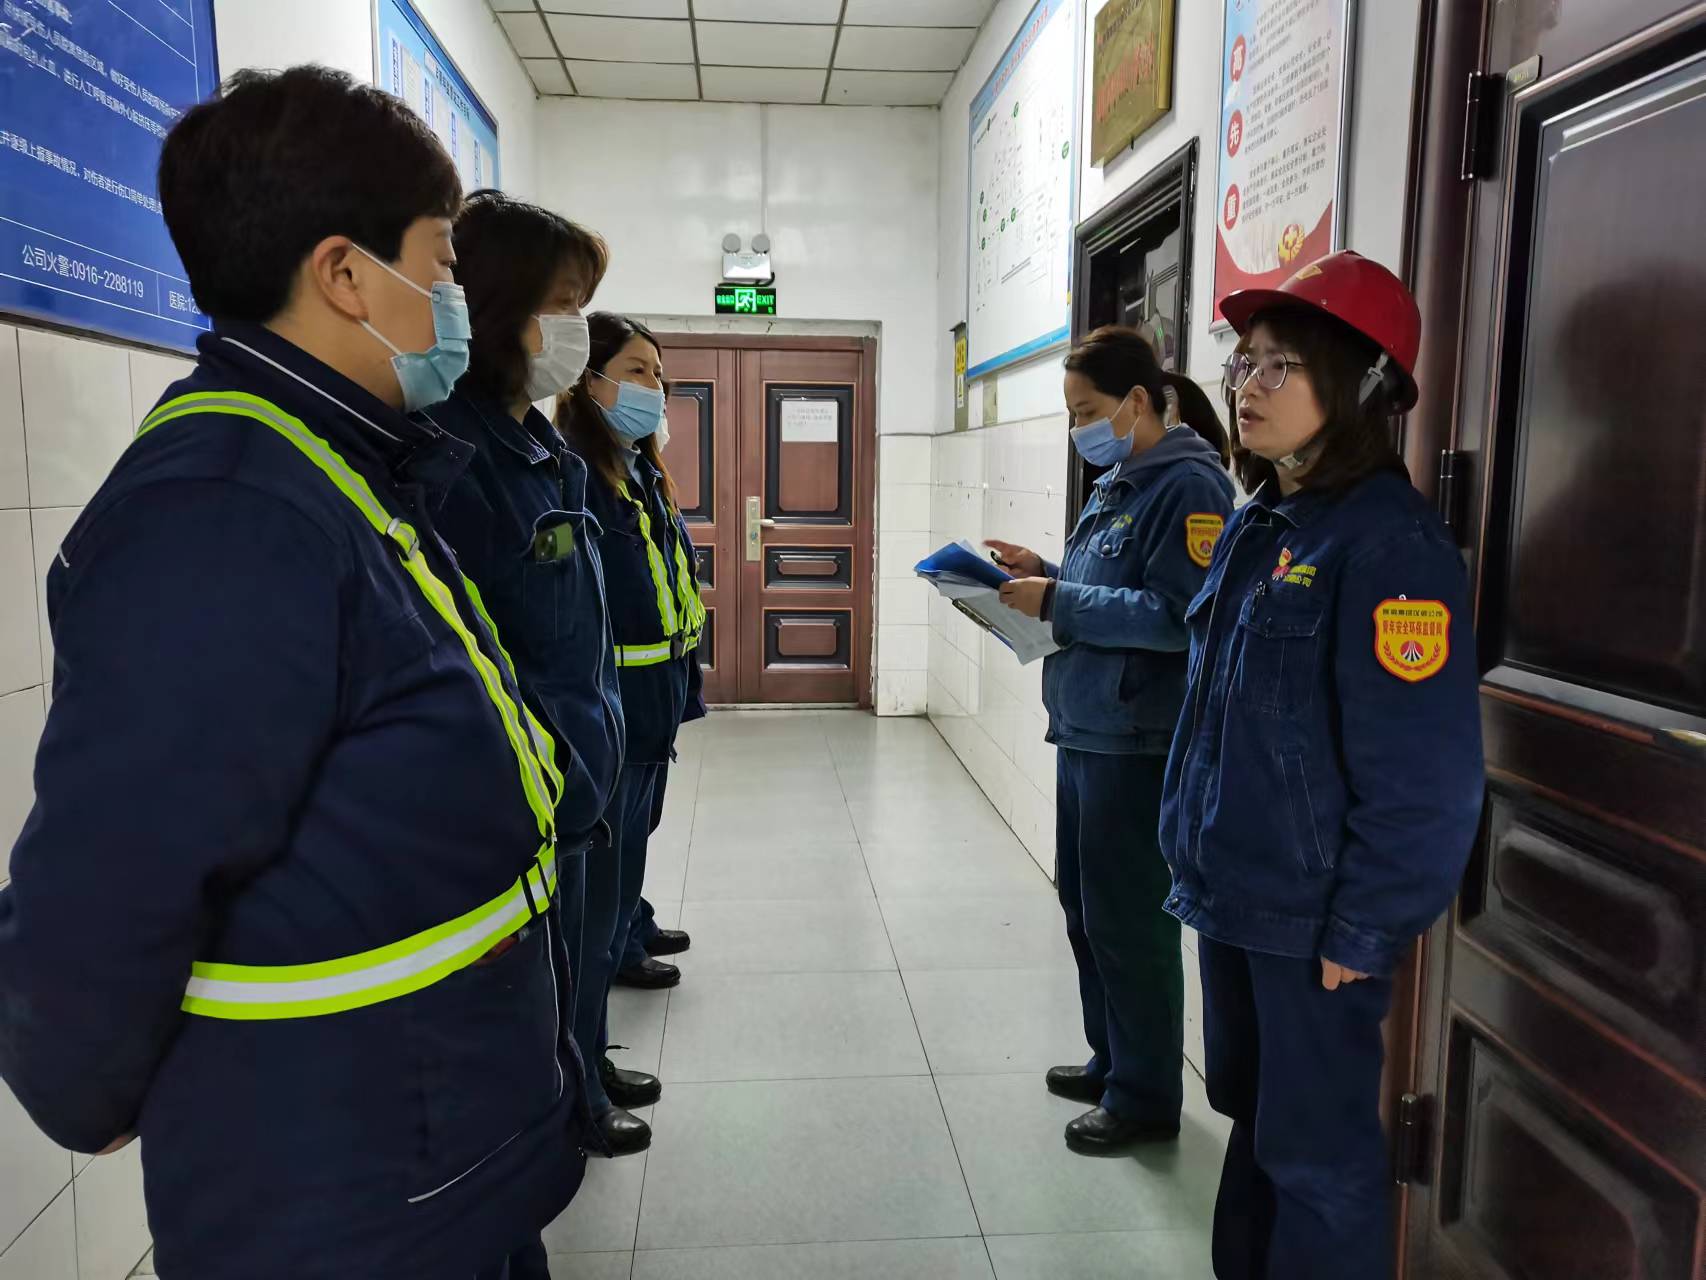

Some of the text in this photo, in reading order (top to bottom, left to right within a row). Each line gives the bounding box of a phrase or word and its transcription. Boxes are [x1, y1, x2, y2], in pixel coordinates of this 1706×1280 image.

[21, 243, 144, 298] 公司火警:0916-2288119
[169, 290, 201, 315] 医院:12
[756, 294, 775, 305] EXIT
